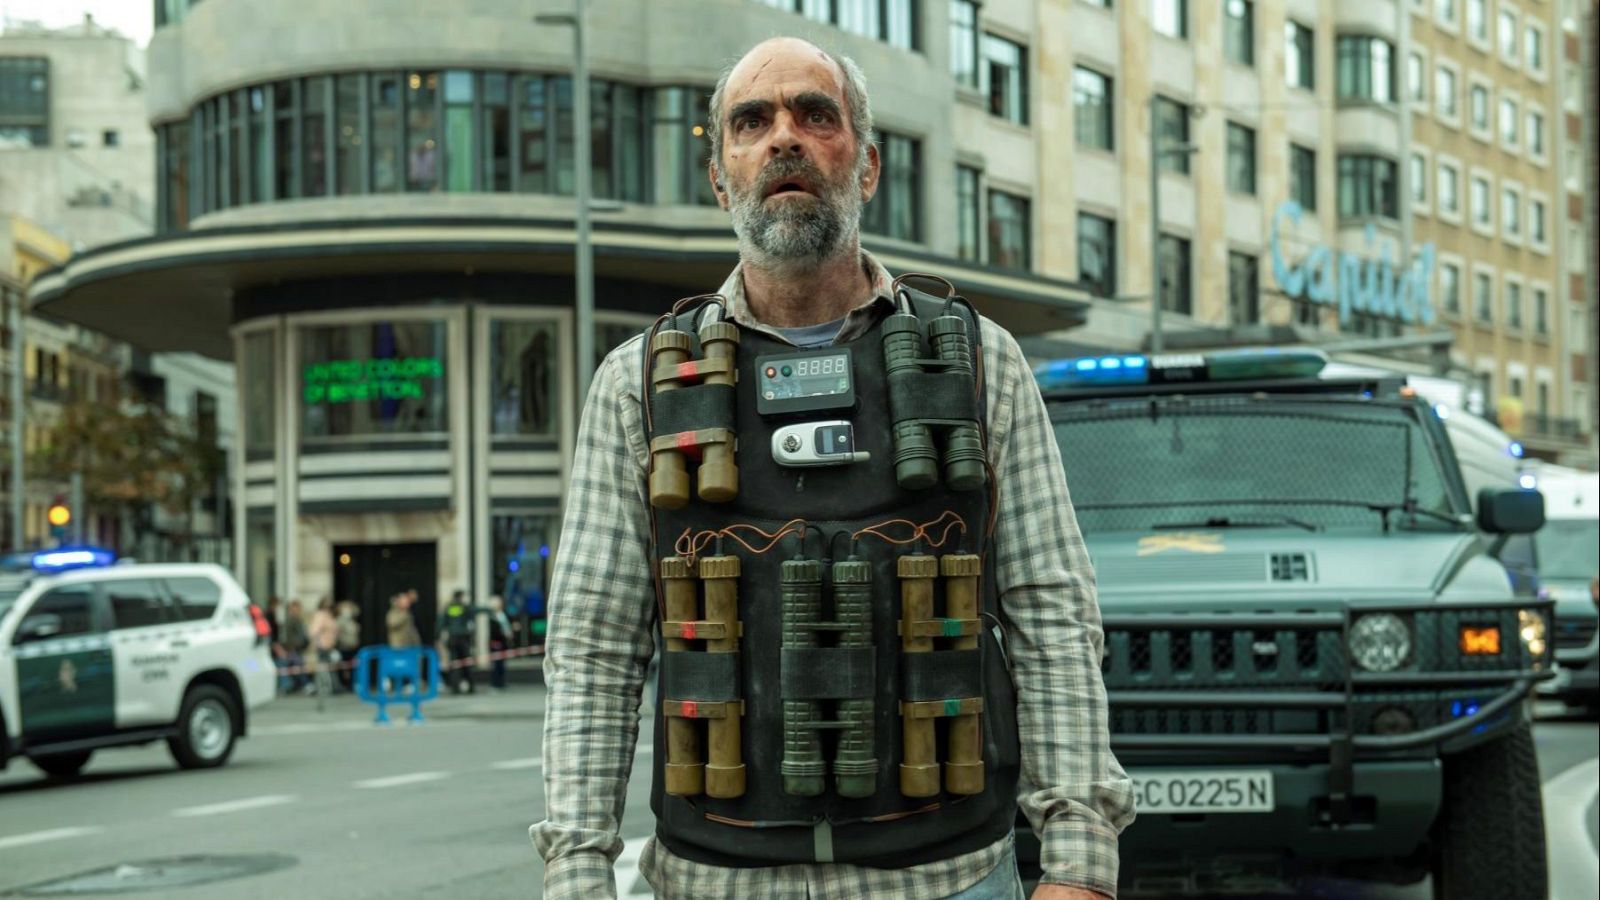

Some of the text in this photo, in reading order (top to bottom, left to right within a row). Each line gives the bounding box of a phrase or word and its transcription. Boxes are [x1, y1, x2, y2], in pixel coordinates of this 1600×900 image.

[1271, 201, 1436, 326] Capitol
[366, 357, 443, 379] COLORS
[1167, 778, 1243, 807] 0225
